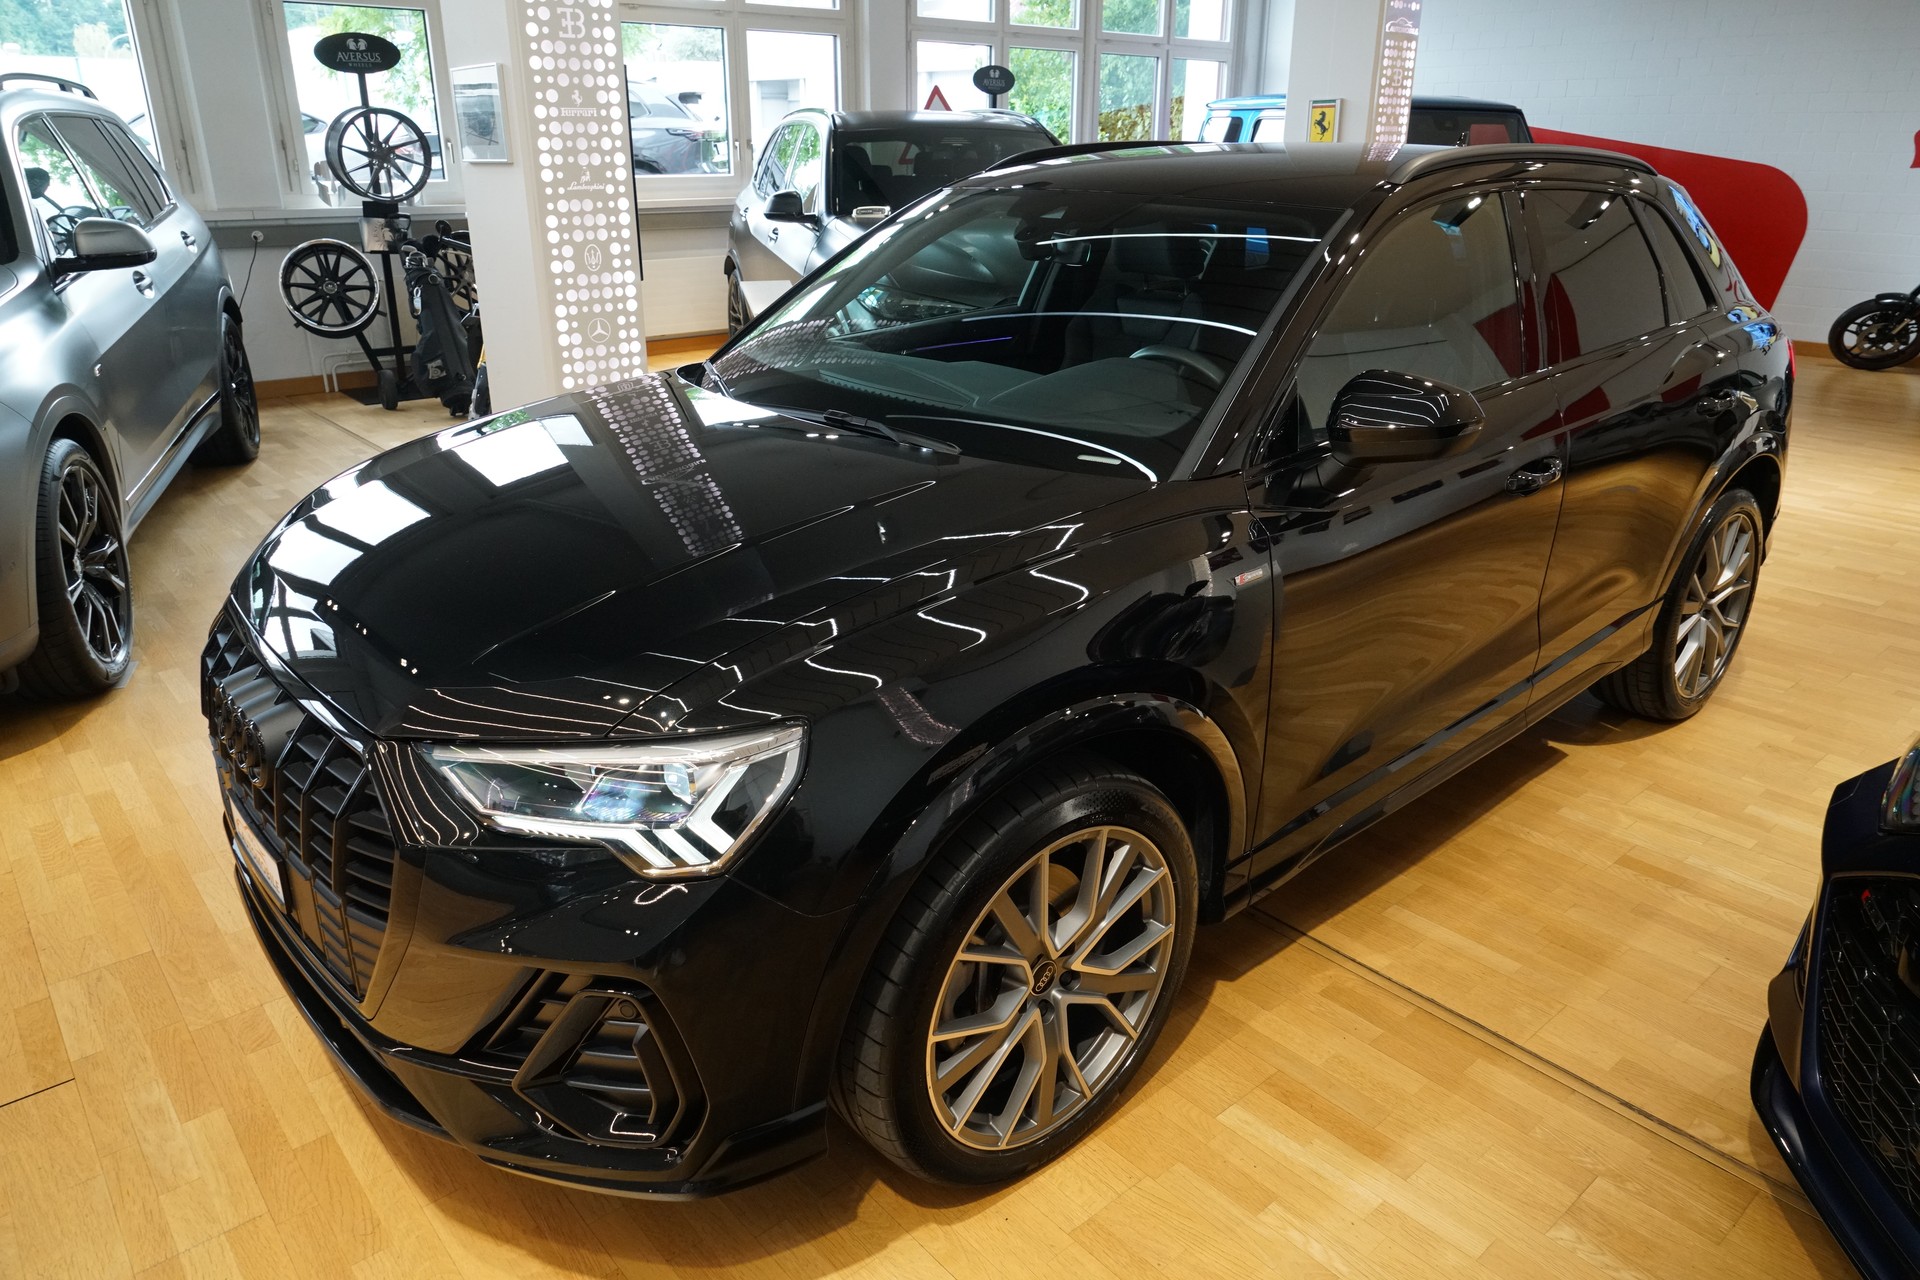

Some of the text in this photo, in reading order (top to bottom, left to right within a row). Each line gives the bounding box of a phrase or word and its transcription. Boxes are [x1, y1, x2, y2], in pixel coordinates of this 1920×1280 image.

[336, 51, 382, 62] AVERSUS
[983, 78, 1006, 87] AVERSUS
[560, 107, 597, 117] Ferrari
[567, 182, 605, 192] Lamborghini
